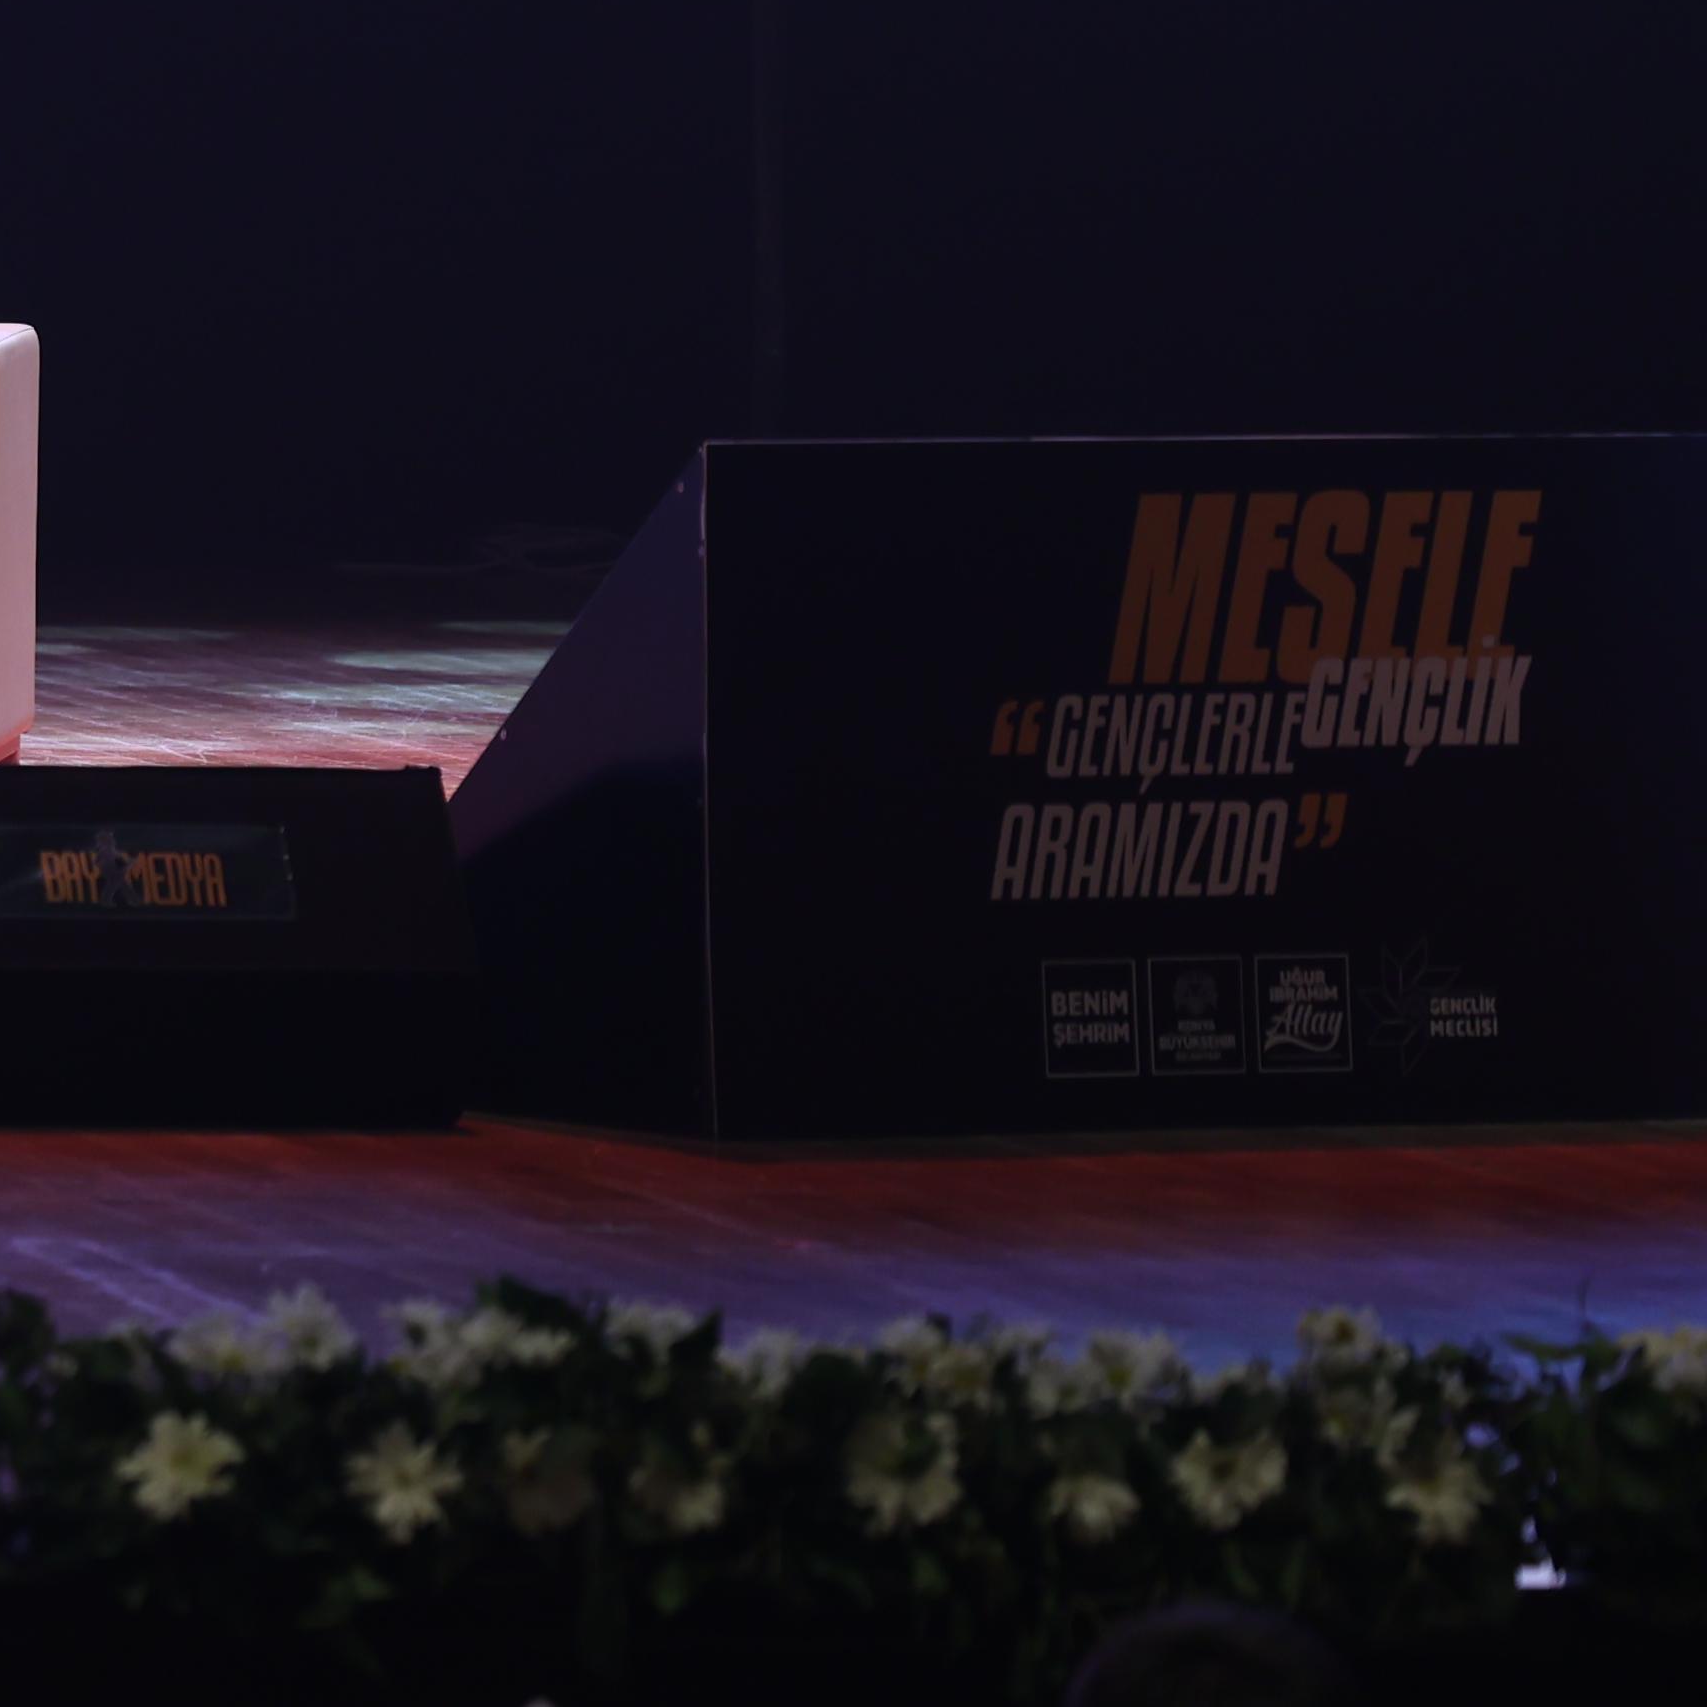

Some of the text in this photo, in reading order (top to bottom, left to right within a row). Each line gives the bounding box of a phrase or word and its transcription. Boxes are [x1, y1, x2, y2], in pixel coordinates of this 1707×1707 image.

[1108, 490, 1542, 684] MESELE
[1300, 634, 1532, 766] GENÇLİK
[39, 848, 101, 906] BAY
[1264, 1001, 1344, 1052] Altay
